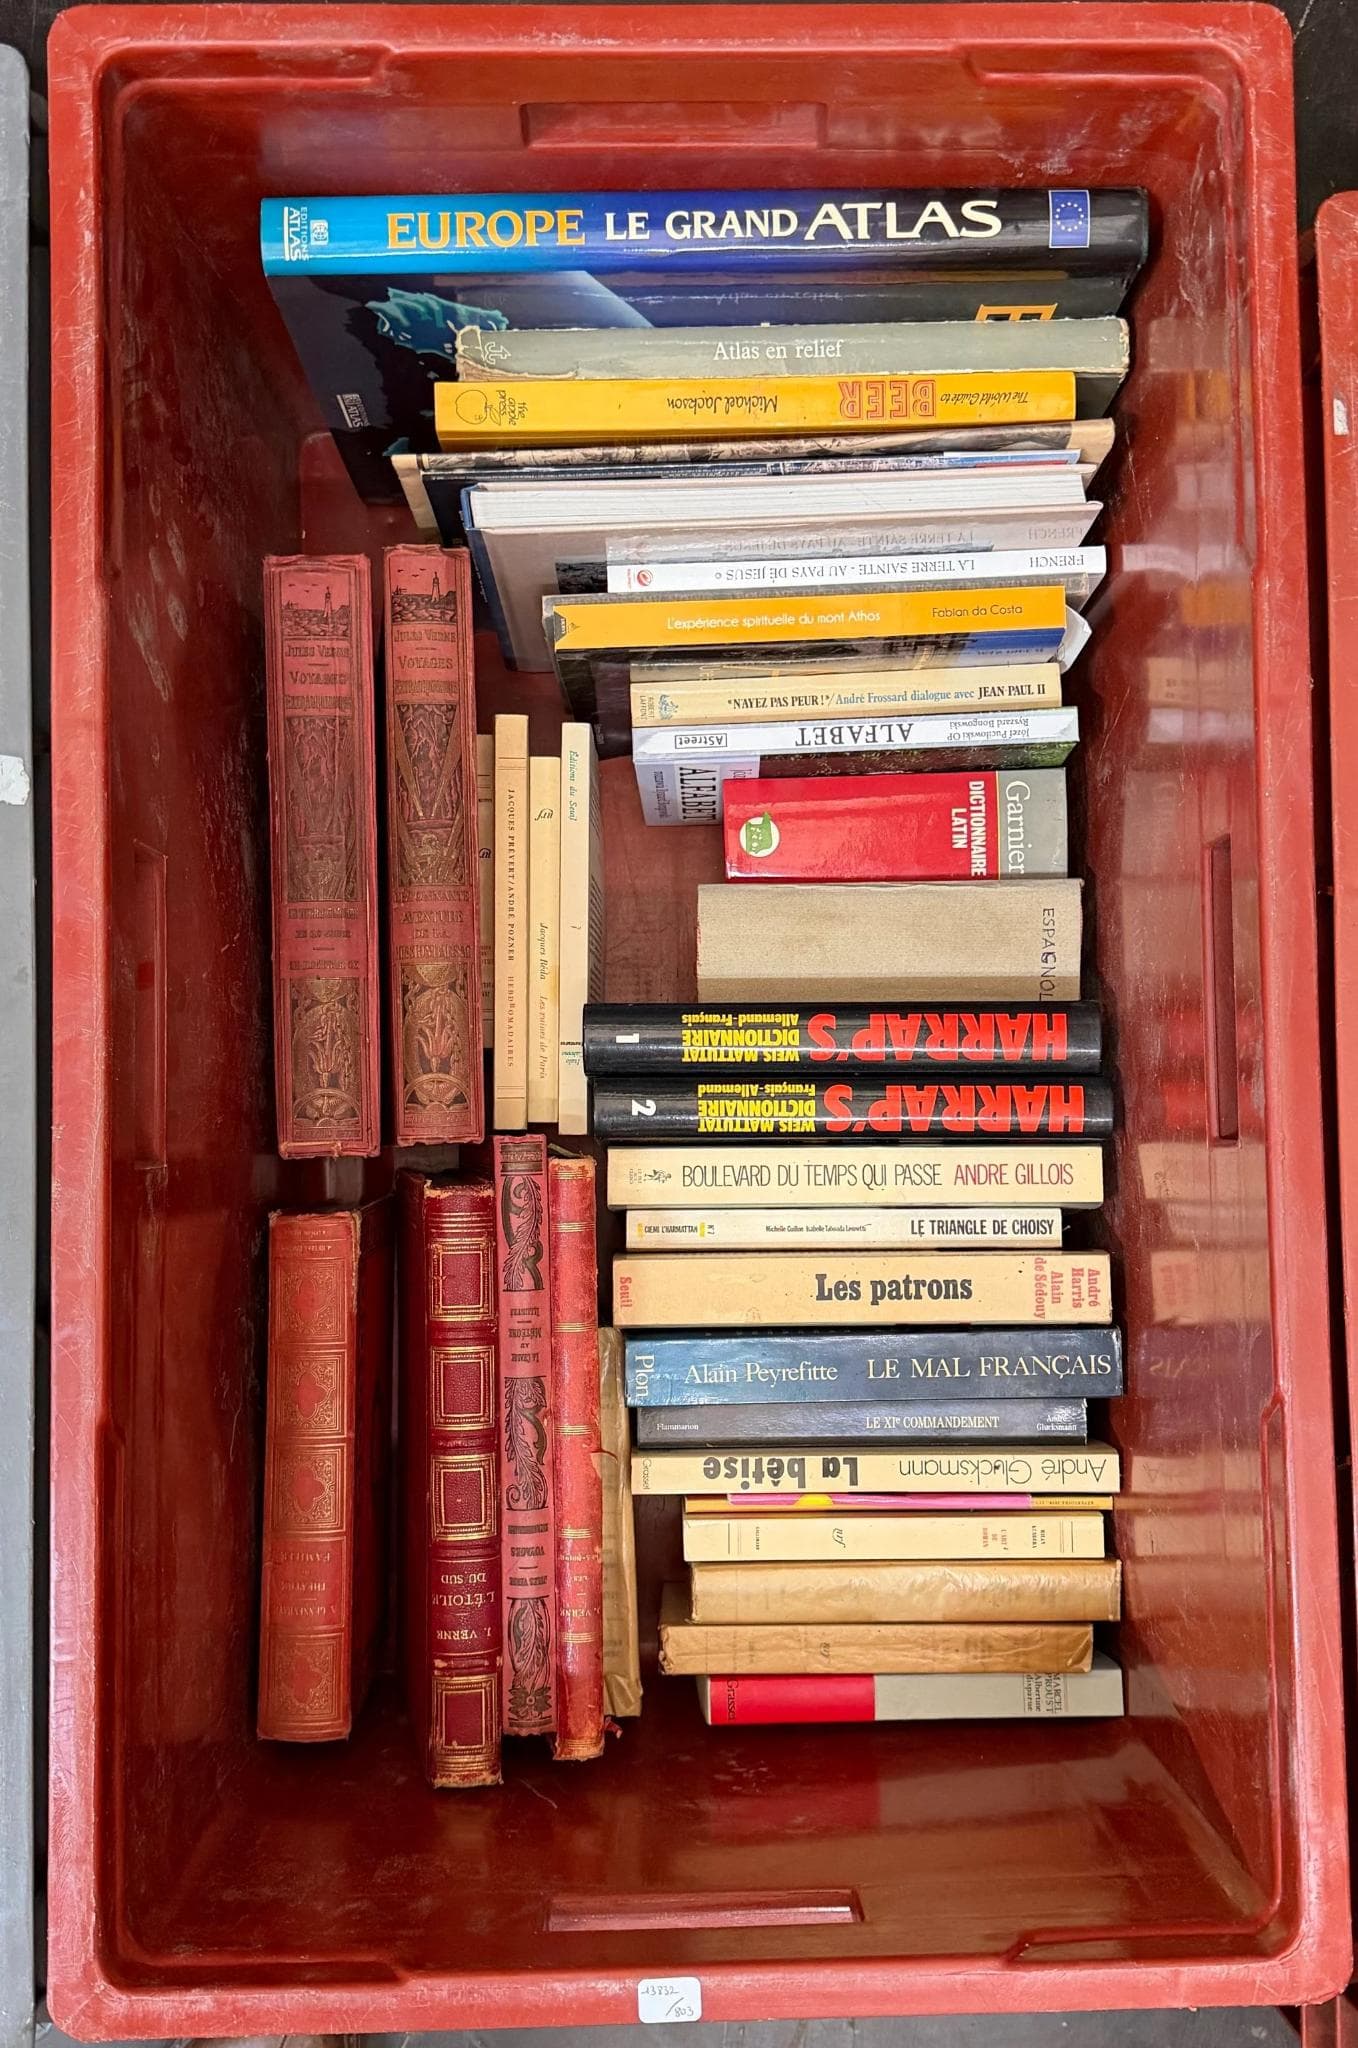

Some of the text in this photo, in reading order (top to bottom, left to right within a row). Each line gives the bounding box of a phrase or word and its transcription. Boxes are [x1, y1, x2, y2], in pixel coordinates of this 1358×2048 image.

[288, 207, 302, 262] ATLAS
[301, 206, 309, 261] EDITIONS
[386, 200, 1002, 249] EUROPE LE GRAND ATLAS
[713, 339, 844, 362] Atlas en relief
[667, 395, 778, 415] Michael Jackson
[839, 379, 936, 419] BEER
[940, 393, 951, 404] to
[952, 393, 980, 406] Guide
[1012, 391, 1029, 404] The
[726, 567, 767, 581] JESUS
[791, 565, 825, 579] PAYS
[829, 564, 848, 578] AU
[858, 562, 908, 576] SAINTE
[911, 560, 952, 573] TERRE
[958, 559, 975, 572] LA
[1029, 554, 1085, 569] FRENCH
[667, 610, 881, 631] L'expérience spirituelle du mont Athos
[932, 604, 1023, 618] Fabian da Costa
[770, 696, 789, 708] PAS
[867, 691, 908, 703] Frossard
[910, 689, 951, 704] dialogue
[954, 690, 975, 700] avec
[1037, 683, 1046, 695] II
[795, 723, 915, 747] ALFABET
[946, 732, 960, 741] OP
[949, 718, 1029, 731] Ryszard Bongowski
[568, 750, 580, 822] Éditions du Seuil
[679, 766, 717, 821] ALFABET
[507, 789, 515, 831] JACQUES
[951, 807, 968, 850] LATIN
[969, 780, 987, 877] DICTIONNAIRE
[1005, 780, 1034, 875] Garnier
[402, 911, 464, 924] AVENTURE
[507, 923, 515, 961] POZNER
[1039, 907, 1057, 1001] ESPAGNOL
[538, 922, 549, 1079] Jacques Réda Les ruines de Paris
[682, 1011, 799, 1027] Allemand-Français
[615, 1032, 640, 1044] 1
[682, 1029, 800, 1046] DICTIONNAIRE
[807, 1013, 1068, 1061] HARRAP'S
[682, 1048, 800, 1062] WEIS MATTUTAT
[698, 1081, 816, 1096] Français-Allemand
[631, 1099, 657, 1116] 2
[698, 1100, 816, 1117] DICTIONNAIRE
[823, 1085, 1085, 1133] HARRAP'S
[698, 1118, 816, 1132] WEIS MATTUTAT
[682, 1163, 1074, 1190] BOULEVARD DU TEMPS QUI PASSE ANDRE GILLOIS
[911, 1219, 1054, 1236] LE TRIANGLE DE CHOISY
[619, 1276, 633, 1308] Seuil
[815, 1274, 973, 1306] Les patrons
[1034, 1257, 1047, 1320] de Sédouy
[1051, 1270, 1064, 1305] Alain
[1072, 1267, 1085, 1309] Harris
[1087, 1267, 1101, 1307] André
[634, 1354, 655, 1400] Plon
[685, 1361, 838, 1388] Alain Peyrefitte
[867, 1354, 1112, 1380] LE MAL FRANÇAIS
[656, 1422, 699, 1431] Flammarion
[866, 1416, 881, 1429] LE
[903, 1415, 1000, 1429] COMMANDEMENT
[642, 1458, 652, 1490] Grasset
[703, 1456, 859, 1490] La bêtise
[899, 1458, 1107, 1485] André Glucksmann
[832, 1527, 846, 1548] nrf
[440, 1573, 464, 1584] SUD
[1025, 1673, 1034, 1712] disparue
[1045, 1672, 1054, 1713] PROUST
[1054, 1672, 1062, 1714] MARCEL
